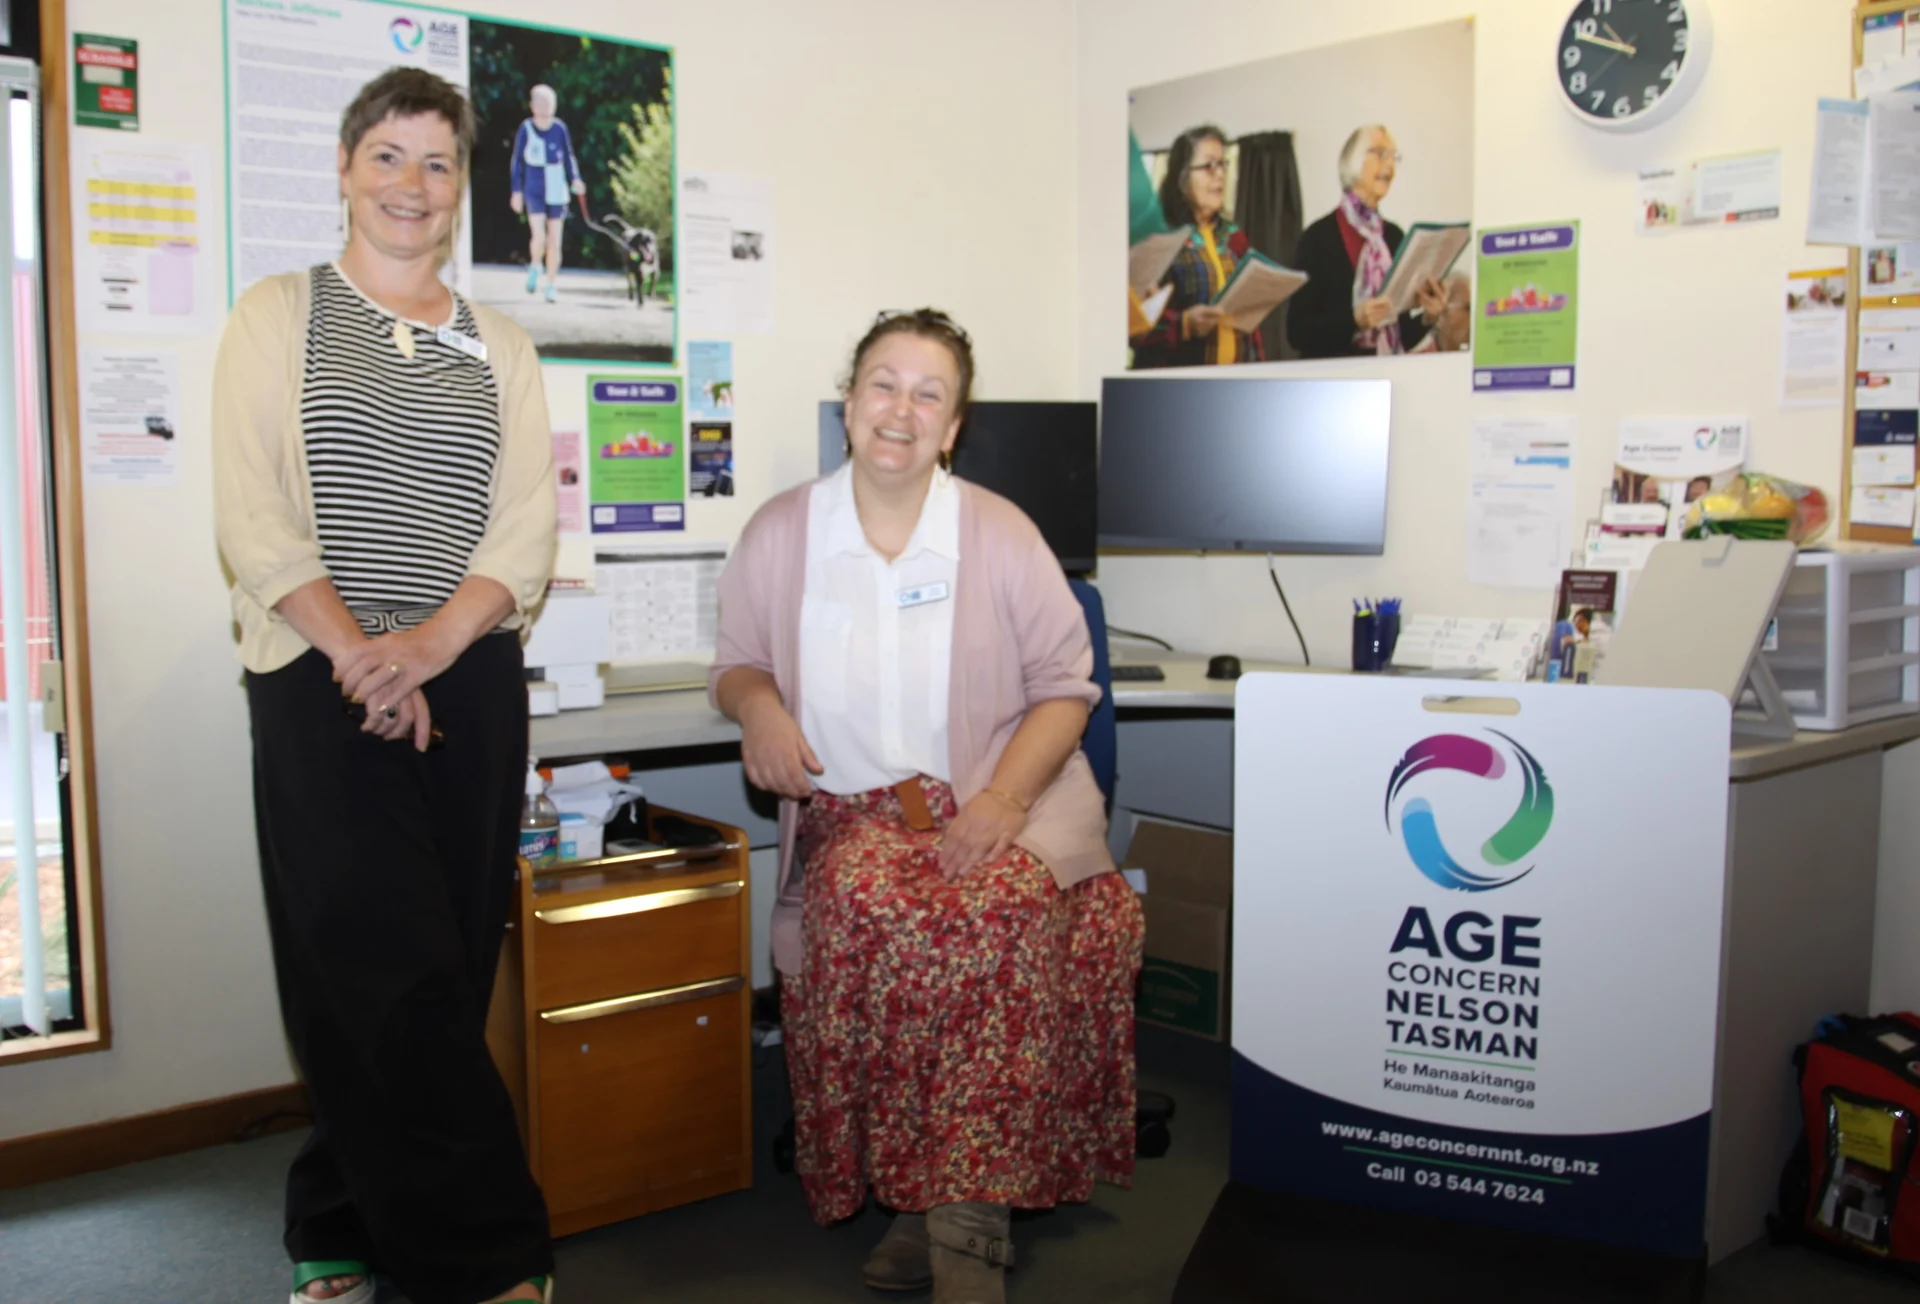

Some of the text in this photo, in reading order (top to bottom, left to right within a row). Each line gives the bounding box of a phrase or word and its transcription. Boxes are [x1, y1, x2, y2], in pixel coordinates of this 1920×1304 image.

[1667, 0, 1684, 23] 2
[1572, 17, 1598, 41] 10
[1673, 28, 1687, 52] 3
[1563, 45, 1582, 69] 9
[1660, 60, 1678, 80] 4
[1569, 71, 1587, 95] 8
[1591, 90, 1606, 112] 7
[1612, 96, 1631, 118] 6
[1642, 85, 1660, 107] 5
[1389, 905, 1542, 969] AGE
[1387, 961, 1540, 998] CONCERN
[1386, 988, 1539, 1030] NELSON
[1386, 1019, 1538, 1061] TASMAN
[1384, 1059, 1536, 1094] He Manaakitanga
[1383, 1077, 1535, 1110] Kaumātua Aotearoa
[1321, 1121, 1600, 1176] www.ageconcernnt.org.nz
[1366, 1162, 1545, 1205] Call 03 544 7624
